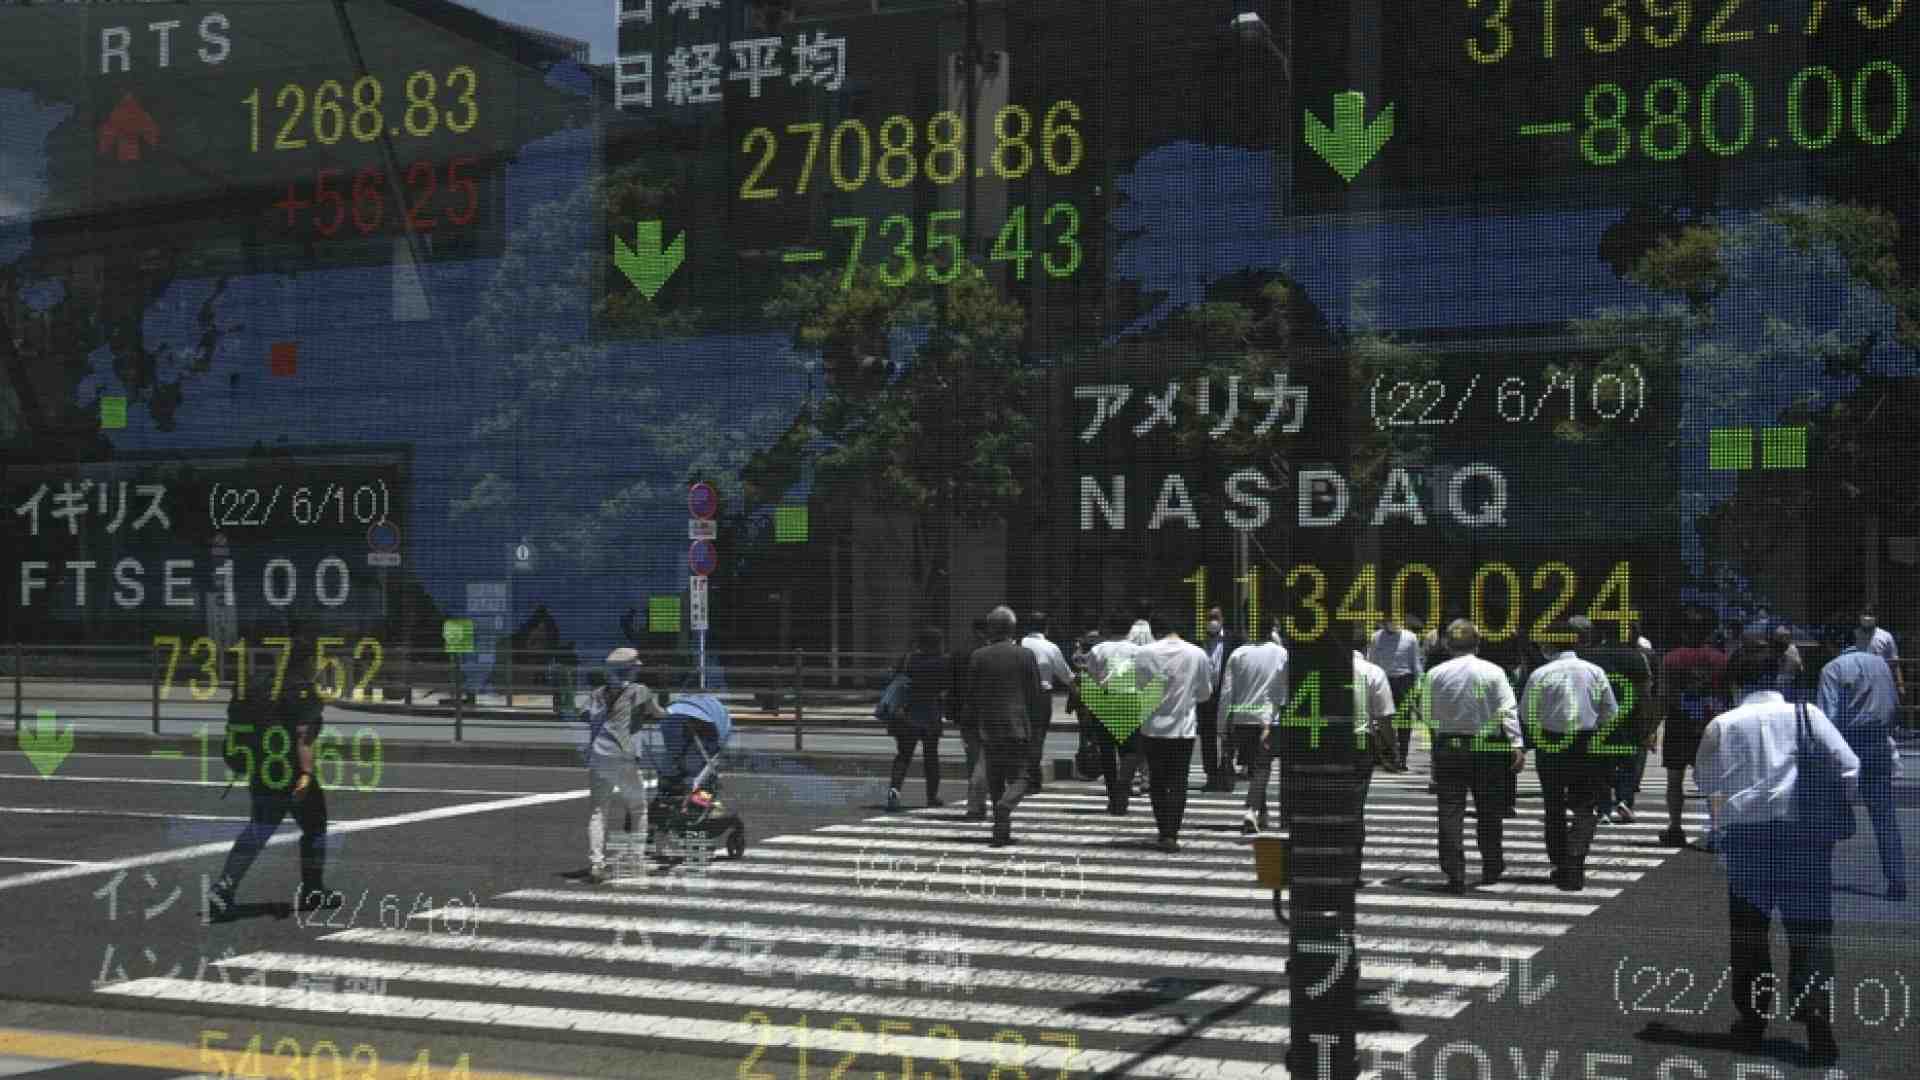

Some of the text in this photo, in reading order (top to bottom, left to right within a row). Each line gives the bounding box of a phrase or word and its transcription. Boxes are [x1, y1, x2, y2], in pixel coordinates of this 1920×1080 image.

[101, 13, 231, 73] RTS
[615, 31, 847, 109] 日経平均
[241, 65, 479, 153] 1268.83
[1519, 60, 1908, 165] -880.00
[739, 100, 1084, 200] 27088.86
[275, 157, 480, 237] +5625
[1073, 374, 1309, 442] アメリカ
[16, 480, 172, 536] イギリス
[1080, 462, 1508, 530] NASDAQ
[20, 557, 351, 607] FTSE100
[153, 635, 385, 700] 7317.52
[93, 870, 234, 924] インド
[200, 1029, 475, 1080] 543034
[735, 1011, 1080, 1080] 2125387
[1308, 1034, 1851, 1080] IBOV
